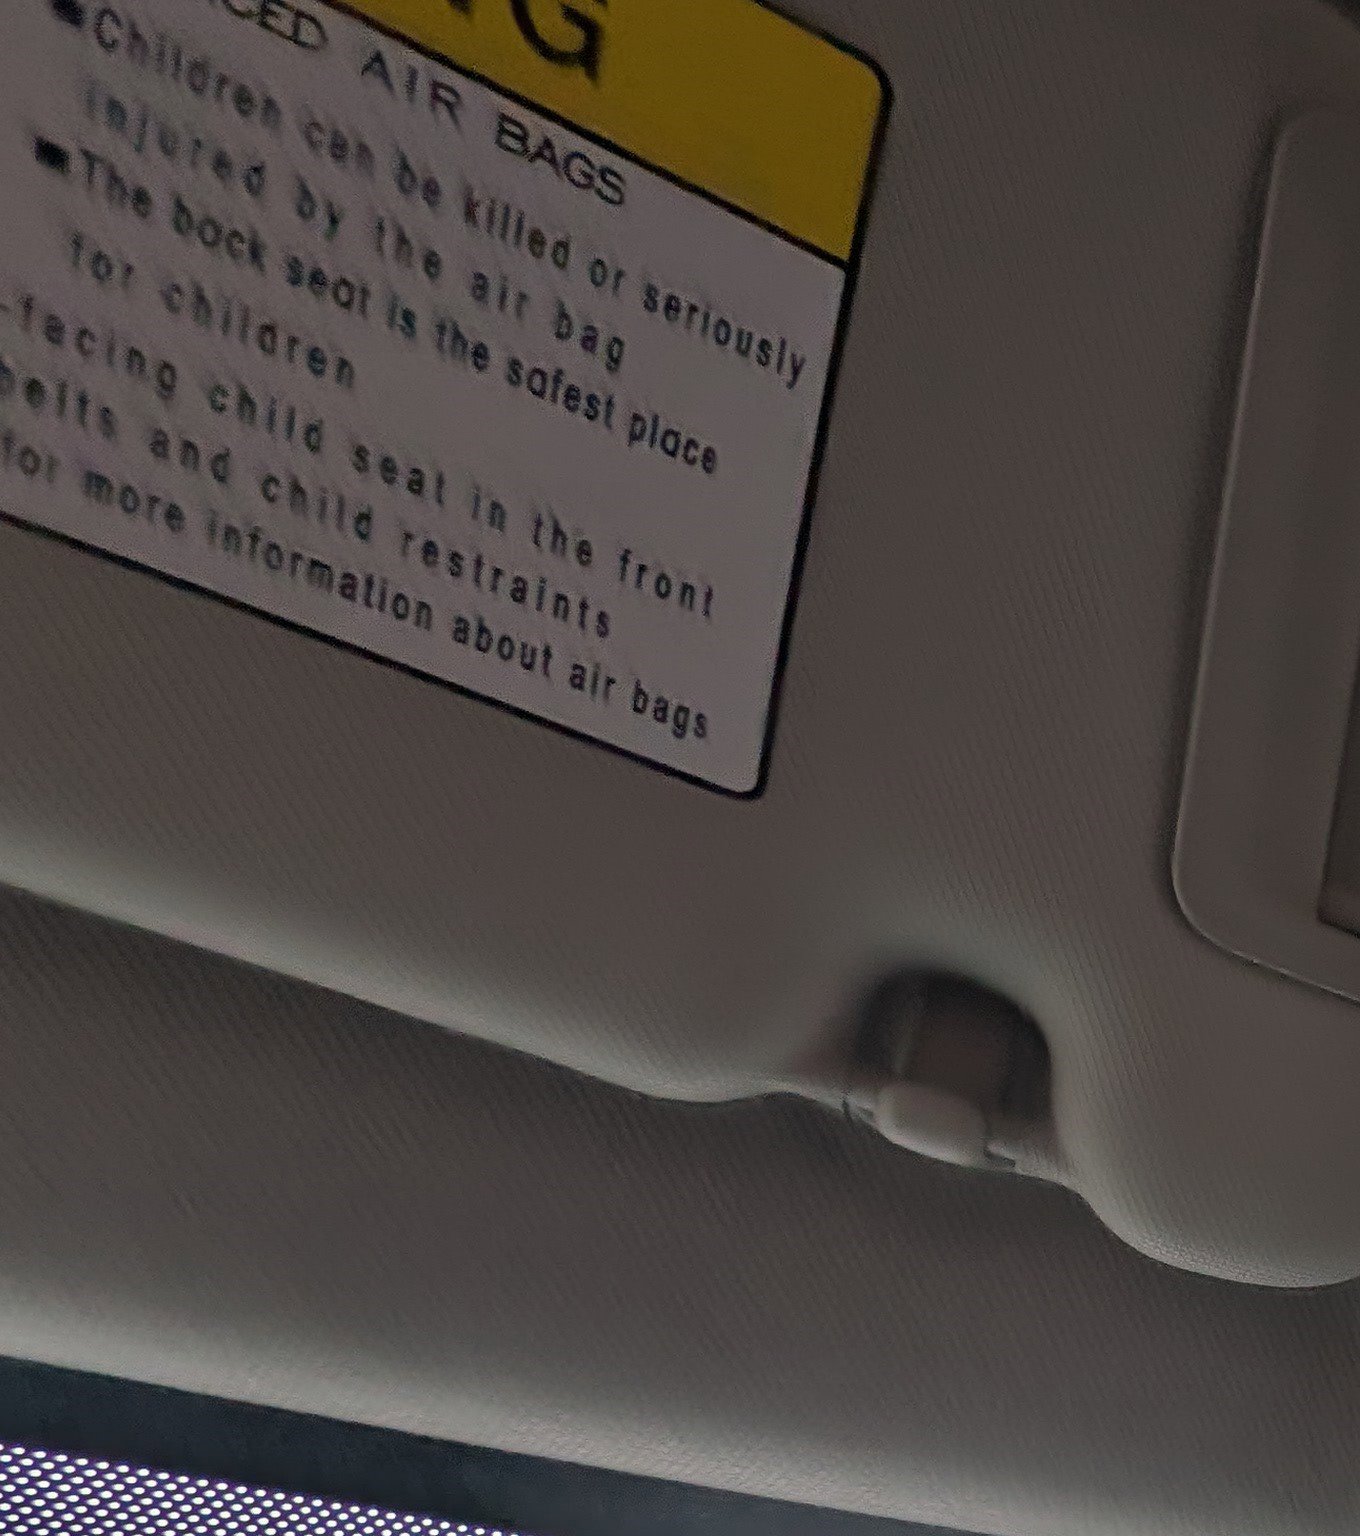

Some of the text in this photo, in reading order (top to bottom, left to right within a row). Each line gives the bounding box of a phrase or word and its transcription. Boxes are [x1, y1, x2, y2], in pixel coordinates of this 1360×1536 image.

[84, 78, 625, 373] injured by the air bag
[94, 6, 806, 390] Children can be killed or seriously
[361, 50, 461, 130] AIR
[495, 112, 625, 206] BAGS
[69, 228, 355, 389] for children
[79, 145, 718, 475] The back seat is the safest place
[83, 469, 186, 534] more
[205, 507, 433, 633] information
[452, 611, 552, 679] about
[568, 660, 617, 702] air
[631, 678, 708, 740] bags
[149, 427, 231, 484] and
[260, 471, 374, 544] child
[401, 528, 610, 639] restraints
[208, 382, 323, 453] child
[351, 443, 446, 509] seat
[471, 486, 507, 533] in
[532, 510, 594, 567] the
[617, 547, 714, 617] front
